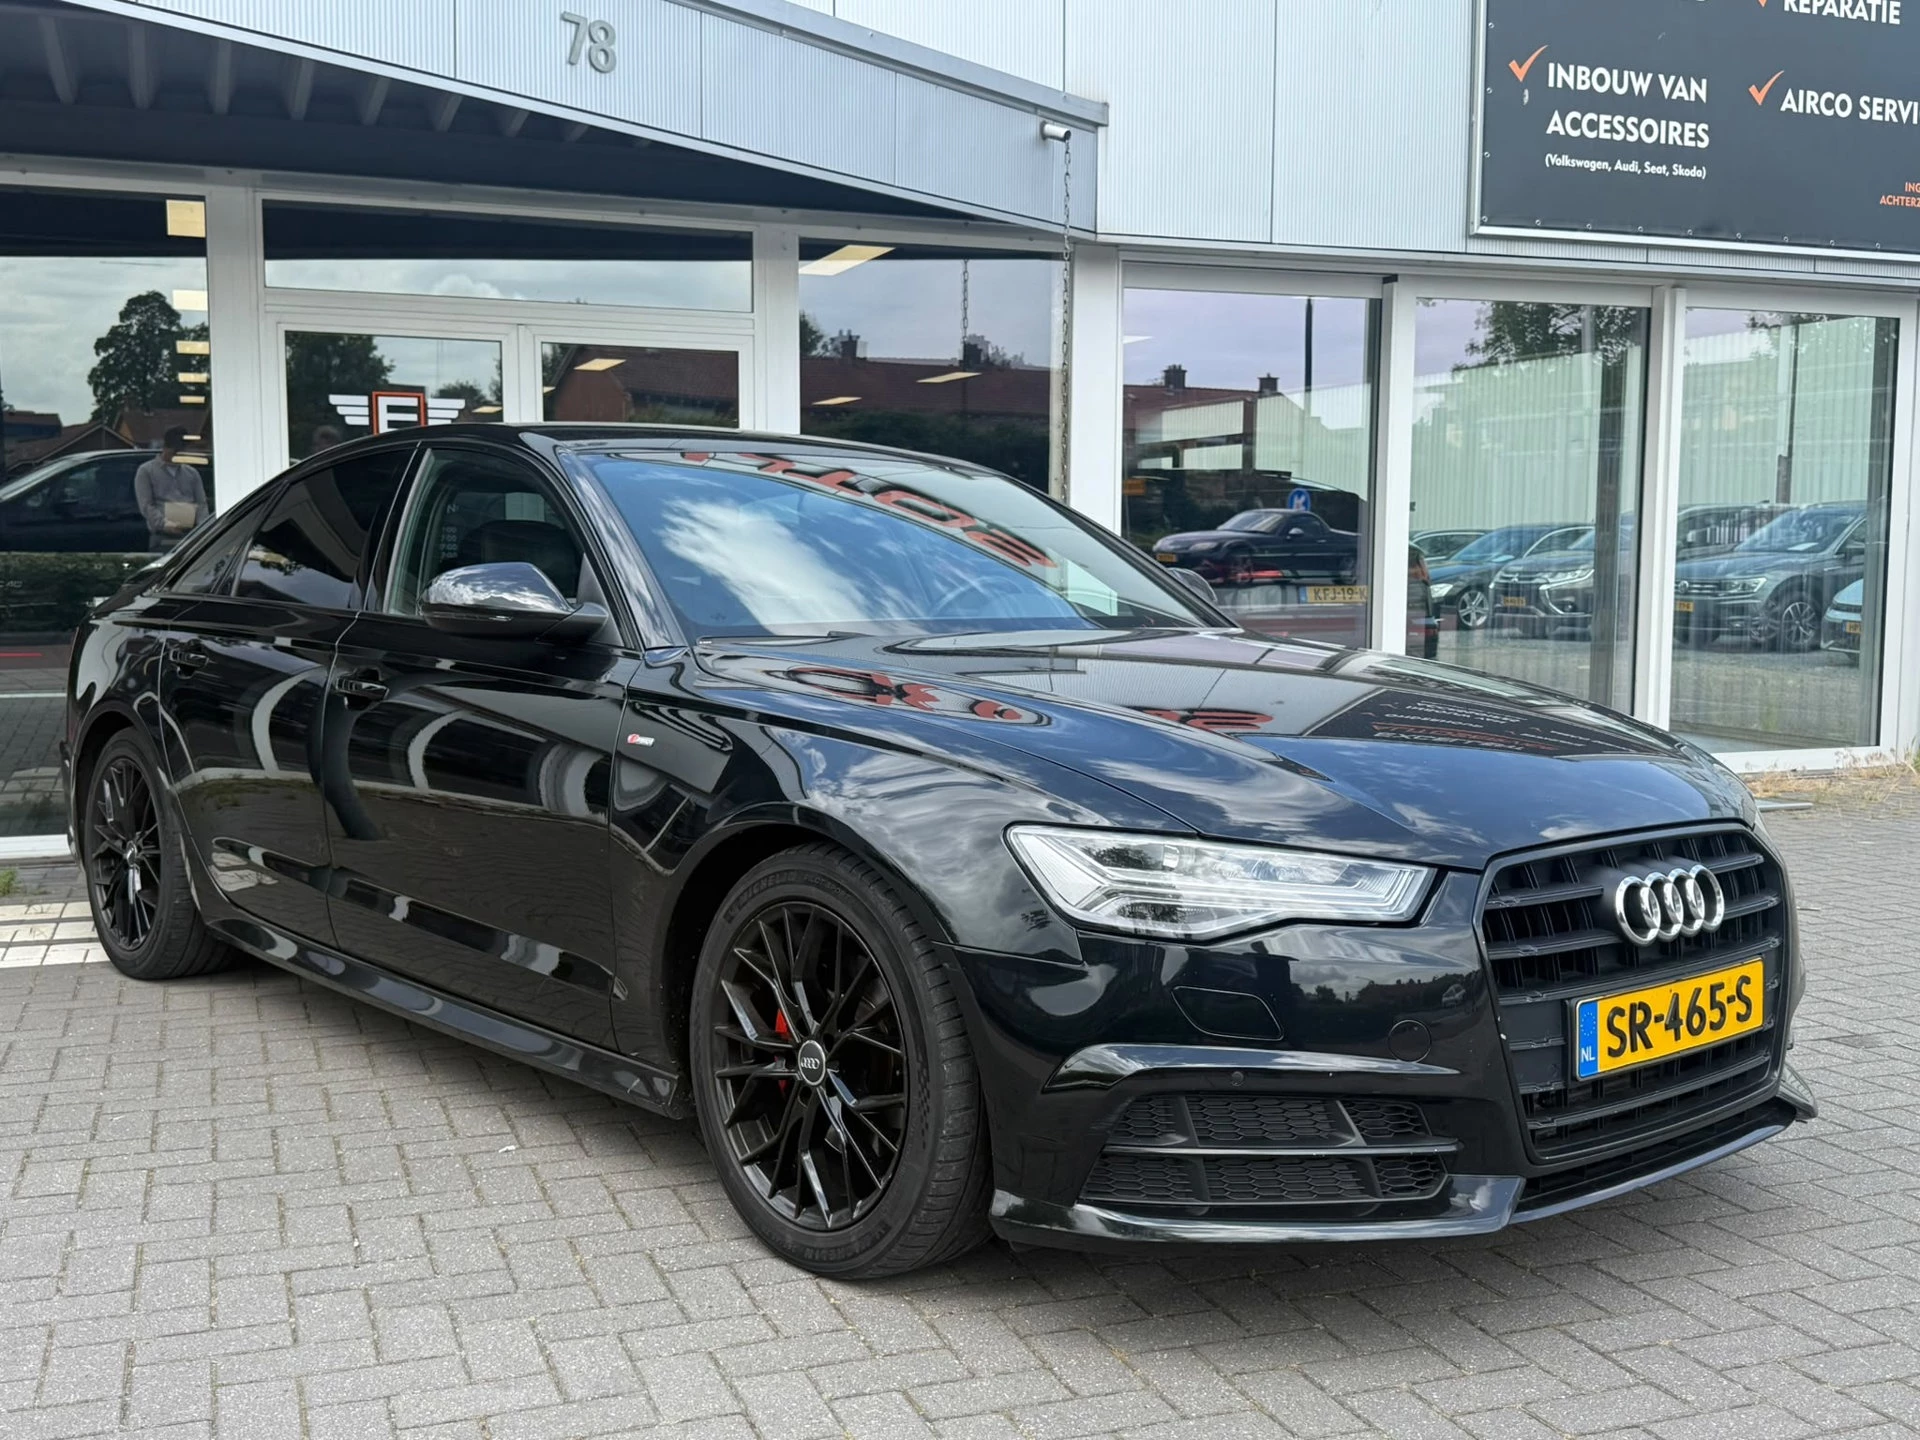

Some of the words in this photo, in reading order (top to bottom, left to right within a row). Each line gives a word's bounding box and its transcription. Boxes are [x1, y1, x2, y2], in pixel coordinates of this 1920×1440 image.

[560, 11, 617, 74] 78
[1548, 62, 1653, 97] INBOUW
[1658, 73, 1707, 104] VAN
[1780, 88, 1853, 118] AIRCO
[1859, 95, 1919, 125] SERVI
[1546, 109, 1710, 149] ACCESSOIRES
[1545, 153, 1612, 172] (Volkswagen,
[1614, 159, 1642, 174] Audi,
[1644, 161, 1670, 177] Seat,
[1672, 163, 1707, 180] Skoda)
[1606, 974, 1752, 1058] SR-465-S
[1581, 1045, 1596, 1064] NL
